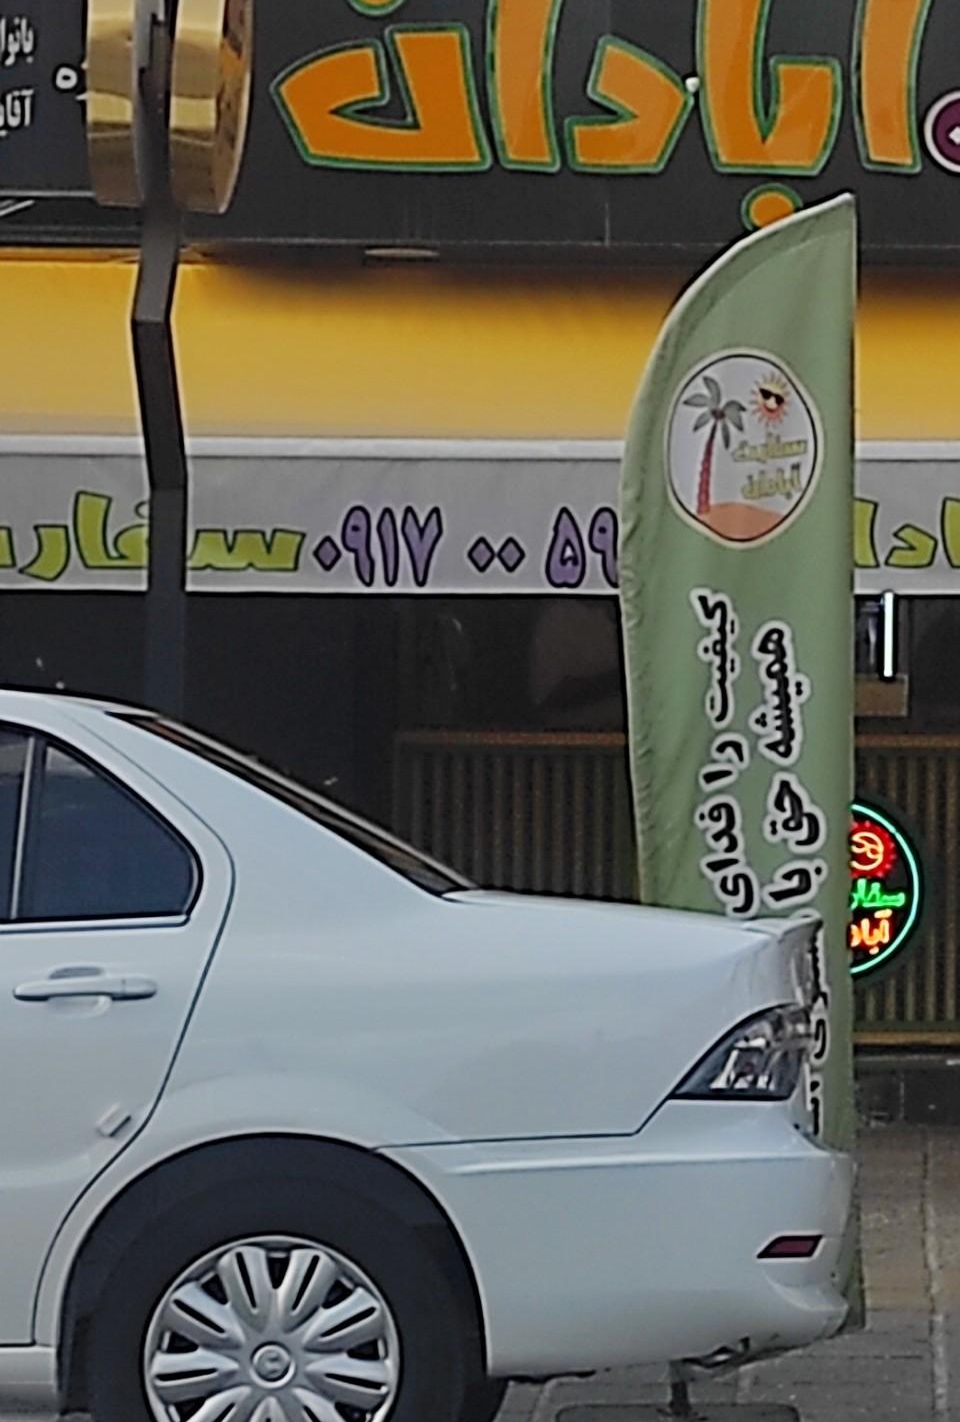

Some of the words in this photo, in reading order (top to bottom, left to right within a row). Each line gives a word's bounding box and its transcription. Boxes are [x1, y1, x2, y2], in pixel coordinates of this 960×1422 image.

[0, 17, 34, 66] بانوا
[0, 88, 34, 136] آقای
[732, 432, 808, 465] سفارت
[741, 462, 802, 500] آبادان
[0, 490, 305, 581] سفار
[313, 505, 444, 587] ۰۹۱۷
[467, 535, 526, 573] ۰۰
[545, 506, 620, 588] ۵۹
[696, 592, 737, 725] کیفیت
[753, 626, 804, 760] همیشه
[701, 739, 746, 786] را
[769, 779, 821, 847] حق
[699, 802, 755, 914] فدای
[768, 865, 823, 904] با
[851, 878, 906, 910] سفار
[851, 909, 893, 955] آباد
